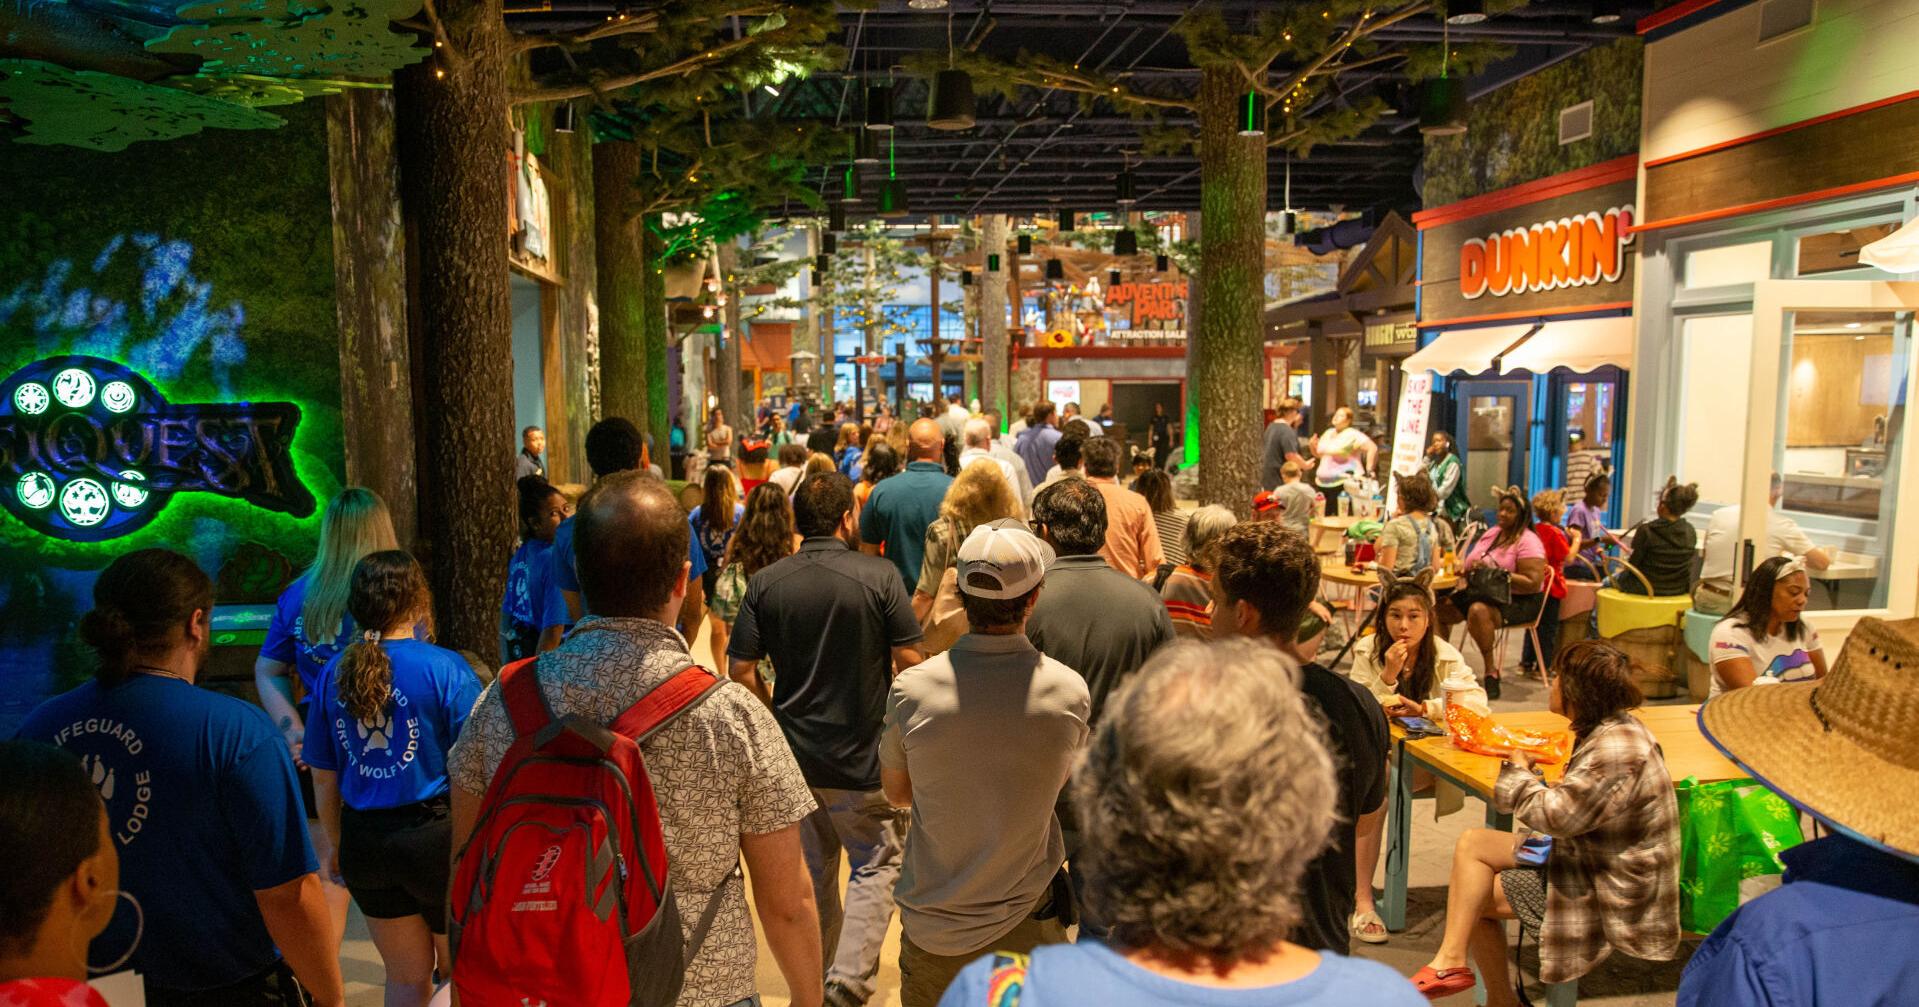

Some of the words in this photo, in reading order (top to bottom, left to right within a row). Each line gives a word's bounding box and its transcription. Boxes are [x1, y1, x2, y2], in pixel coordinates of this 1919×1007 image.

[1460, 204, 1635, 299] DUNKIN'
[1407, 399, 1423, 415] THE
[53, 718, 143, 755] IFEGUARD
[359, 764, 398, 779] WOLF
[396, 717, 420, 770] LODGE
[117, 770, 151, 845] LODGE
